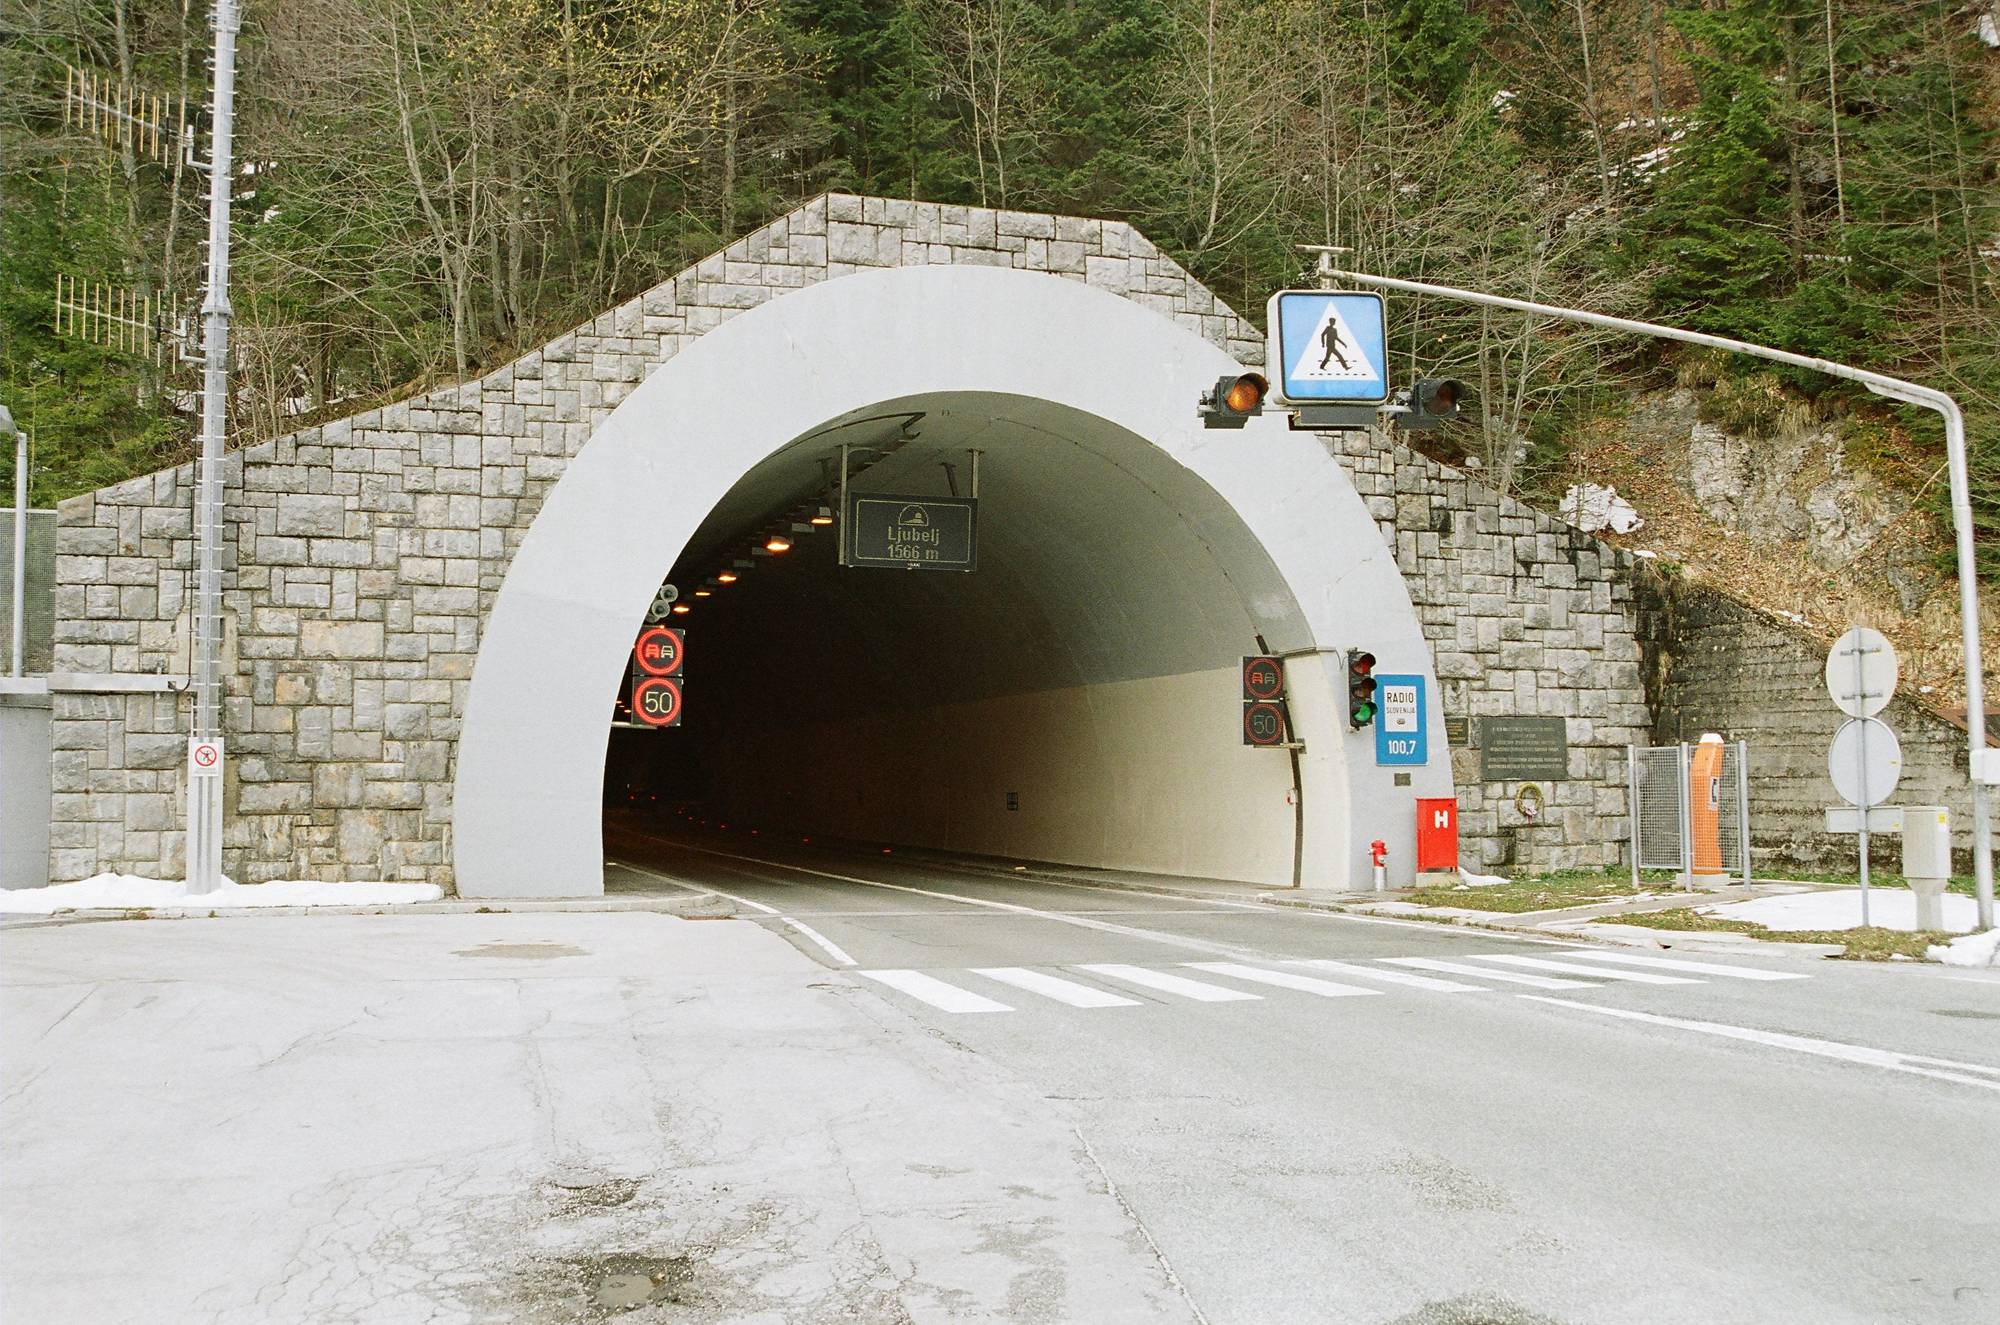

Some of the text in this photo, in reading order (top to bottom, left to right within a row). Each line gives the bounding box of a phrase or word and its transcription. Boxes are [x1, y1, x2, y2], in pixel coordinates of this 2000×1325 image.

[887, 525, 940, 546] Ljubelj
[887, 544, 939, 560] 1566 m
[645, 691, 673, 713] 50
[1386, 692, 1414, 703] RADIO
[1386, 706, 1416, 714] SLOVENIJA
[1253, 715, 1276, 734] 50
[1388, 740, 1416, 755] 100,7
[1434, 810, 1449, 829] H
